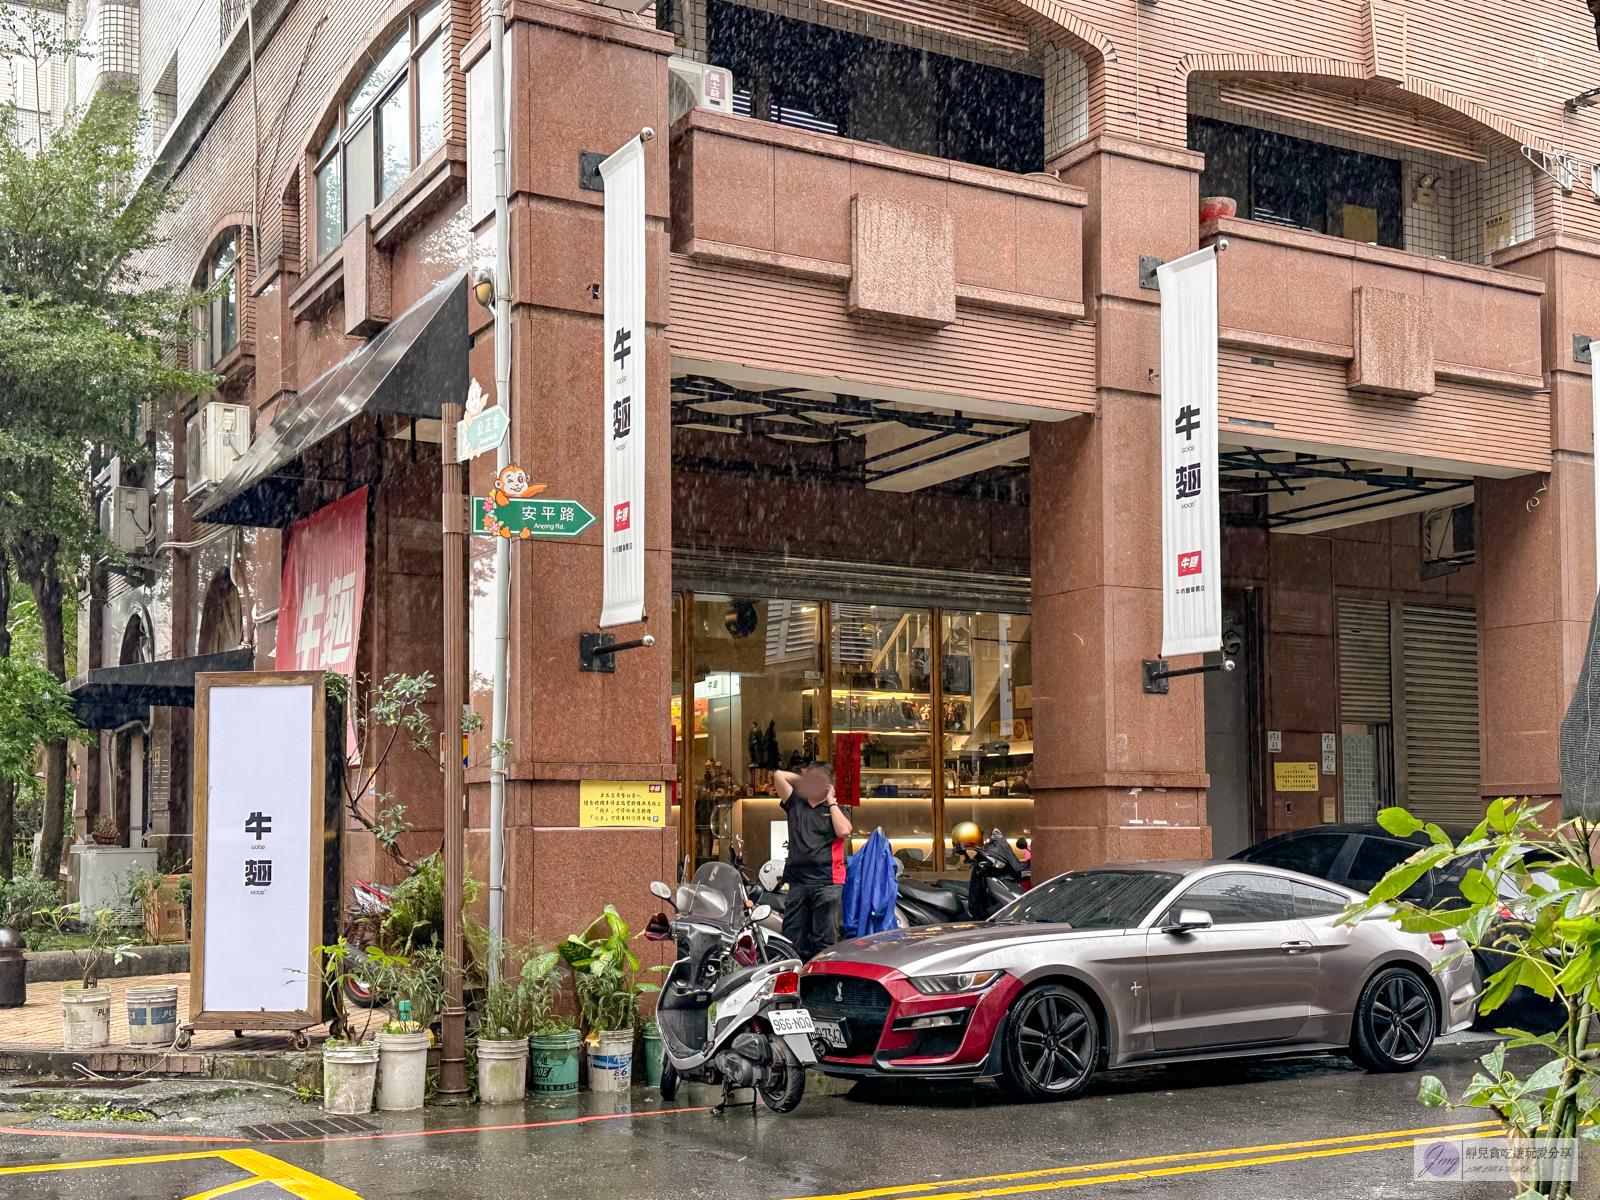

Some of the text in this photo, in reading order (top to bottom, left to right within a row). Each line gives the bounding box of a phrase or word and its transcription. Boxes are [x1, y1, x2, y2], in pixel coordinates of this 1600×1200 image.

[613, 326, 631, 370] 牛
[1175, 404, 1201, 441] 牛
[521, 505, 575, 522] 安平路
[245, 812, 272, 840] 牛
